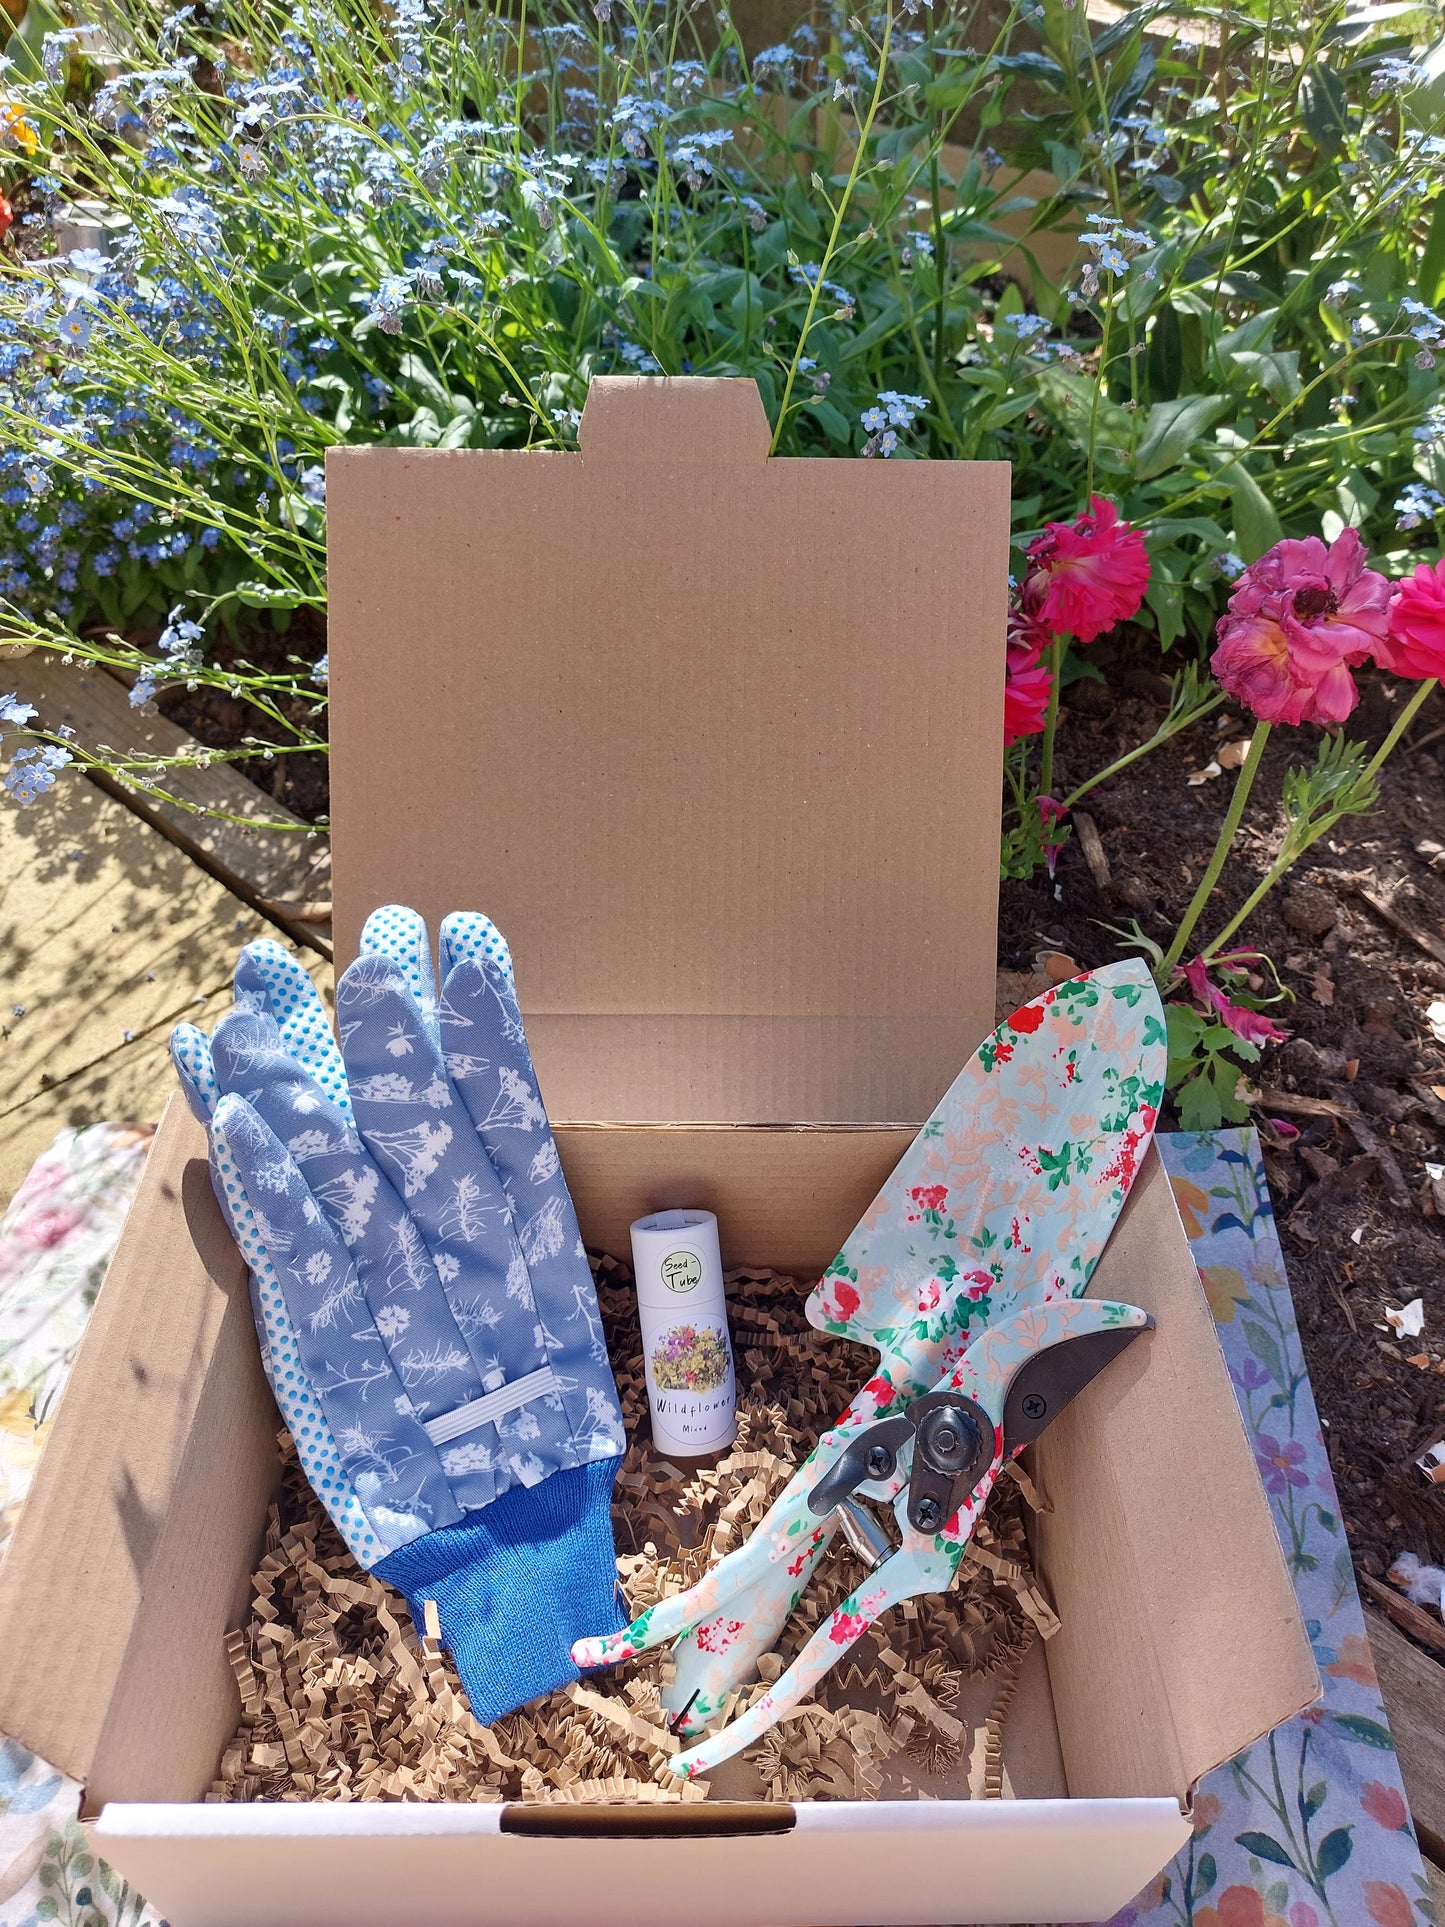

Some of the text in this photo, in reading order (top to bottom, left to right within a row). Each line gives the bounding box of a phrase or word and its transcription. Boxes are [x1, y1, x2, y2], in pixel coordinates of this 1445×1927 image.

[666, 1271, 699, 1289] Tube
[656, 1396, 731, 1417] Wildflower
[682, 1425, 708, 1433] Mixed
